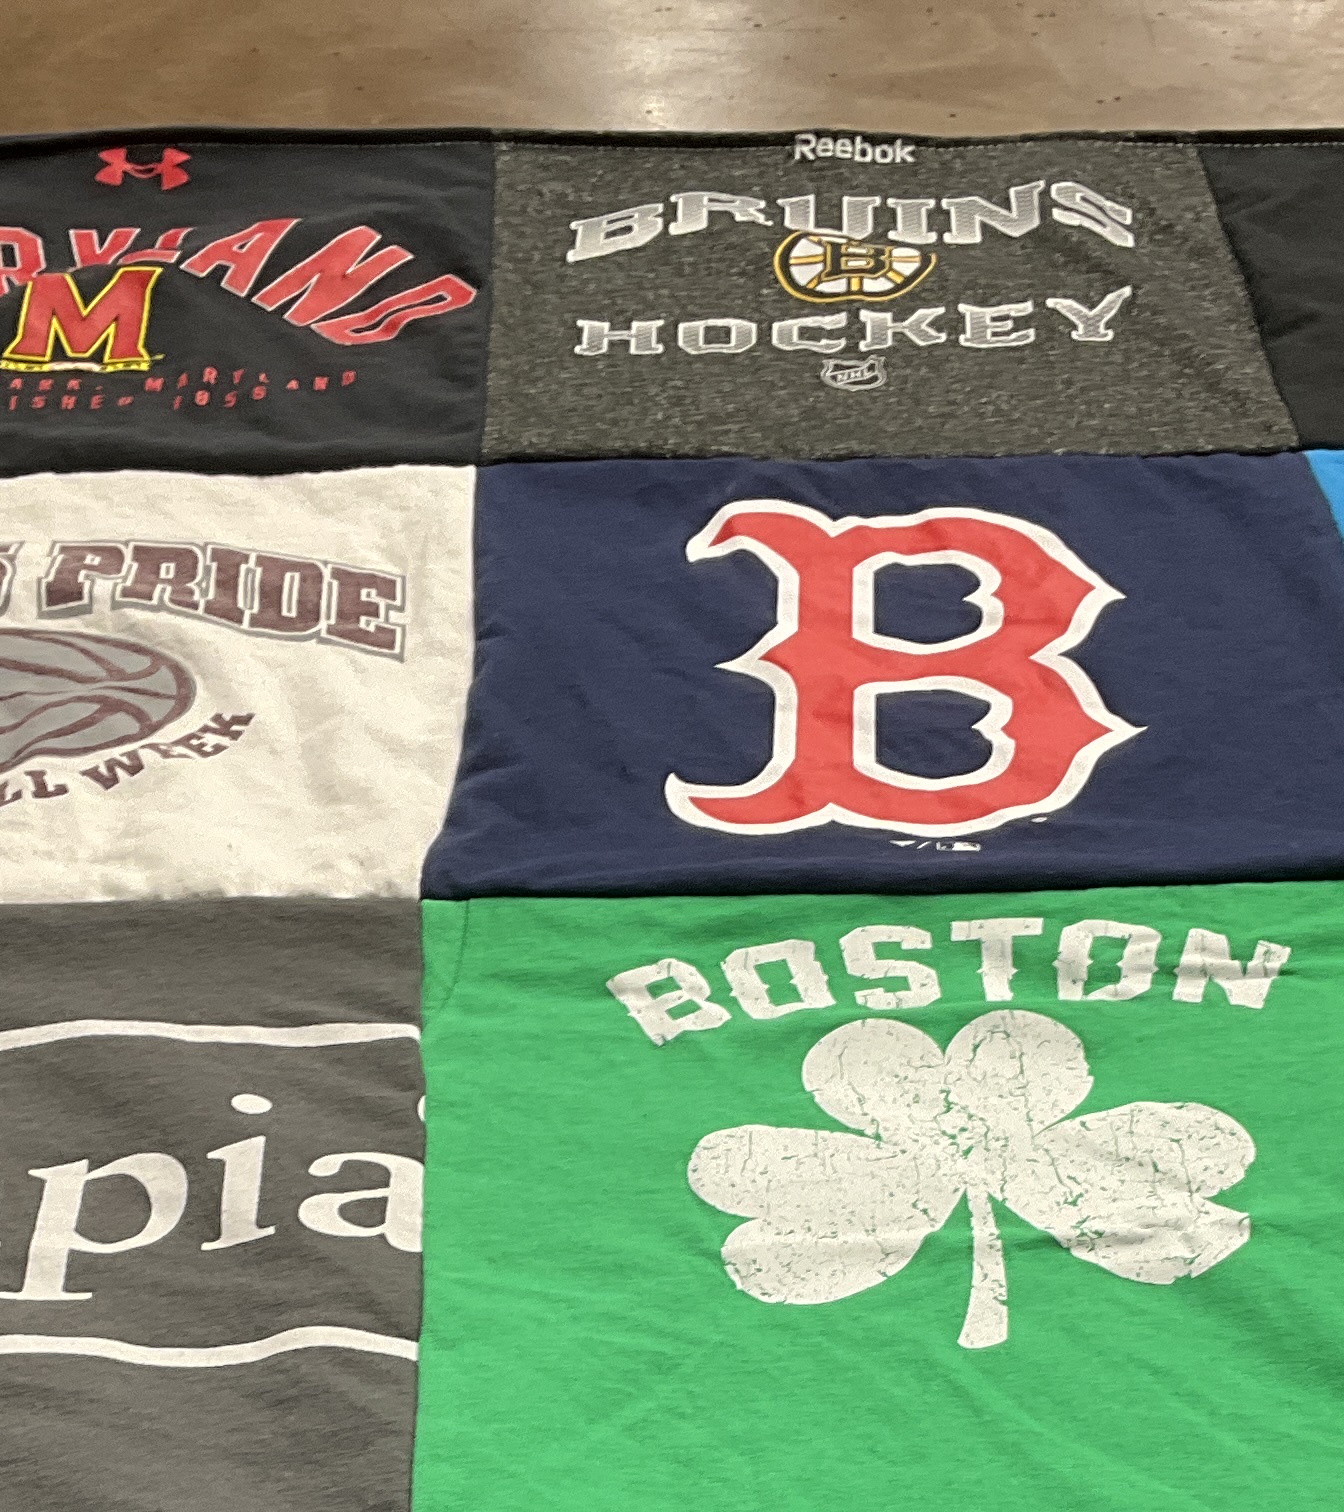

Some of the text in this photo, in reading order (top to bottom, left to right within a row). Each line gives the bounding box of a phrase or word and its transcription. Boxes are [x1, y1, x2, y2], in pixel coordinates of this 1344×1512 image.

[794, 133, 916, 164] Reebok
[565, 180, 1136, 264] BRUINS
[574, 286, 1134, 356] HOCKEY
[37, 539, 407, 662] PRIDE
[664, 498, 1149, 837] B
[79, 712, 255, 790] WEEK
[606, 917, 1291, 1047] BOSTON
